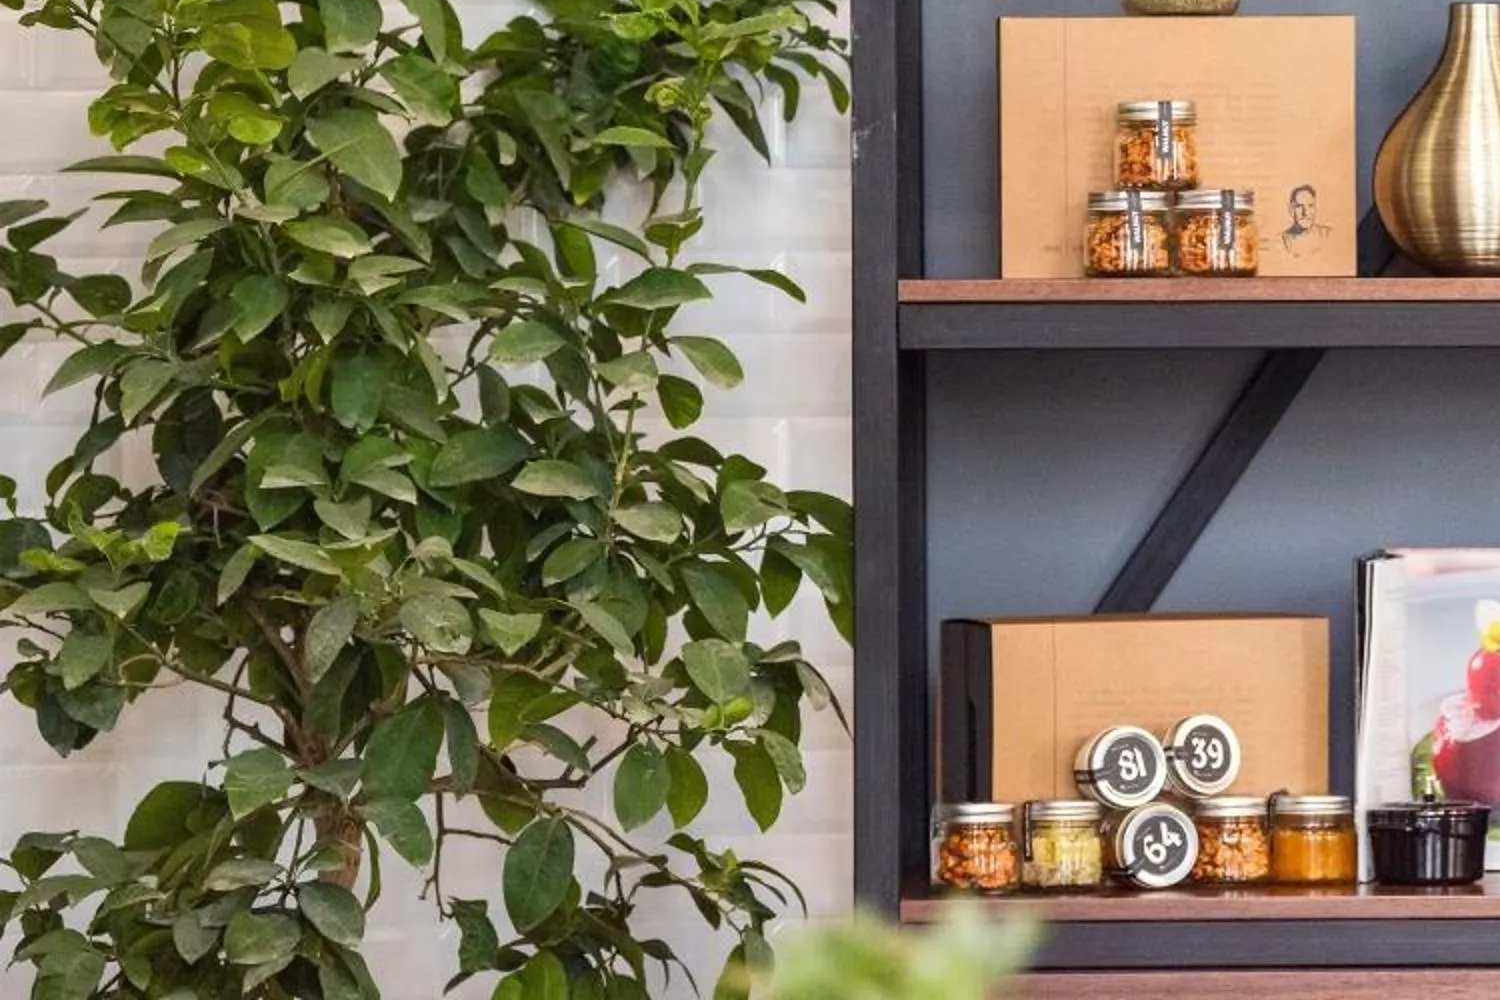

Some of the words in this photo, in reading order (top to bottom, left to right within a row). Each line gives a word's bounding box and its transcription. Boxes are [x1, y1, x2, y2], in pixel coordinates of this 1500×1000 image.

[1118, 747, 1147, 781] 81
[1191, 738, 1224, 770] 39
[1143, 821, 1183, 865] 64
